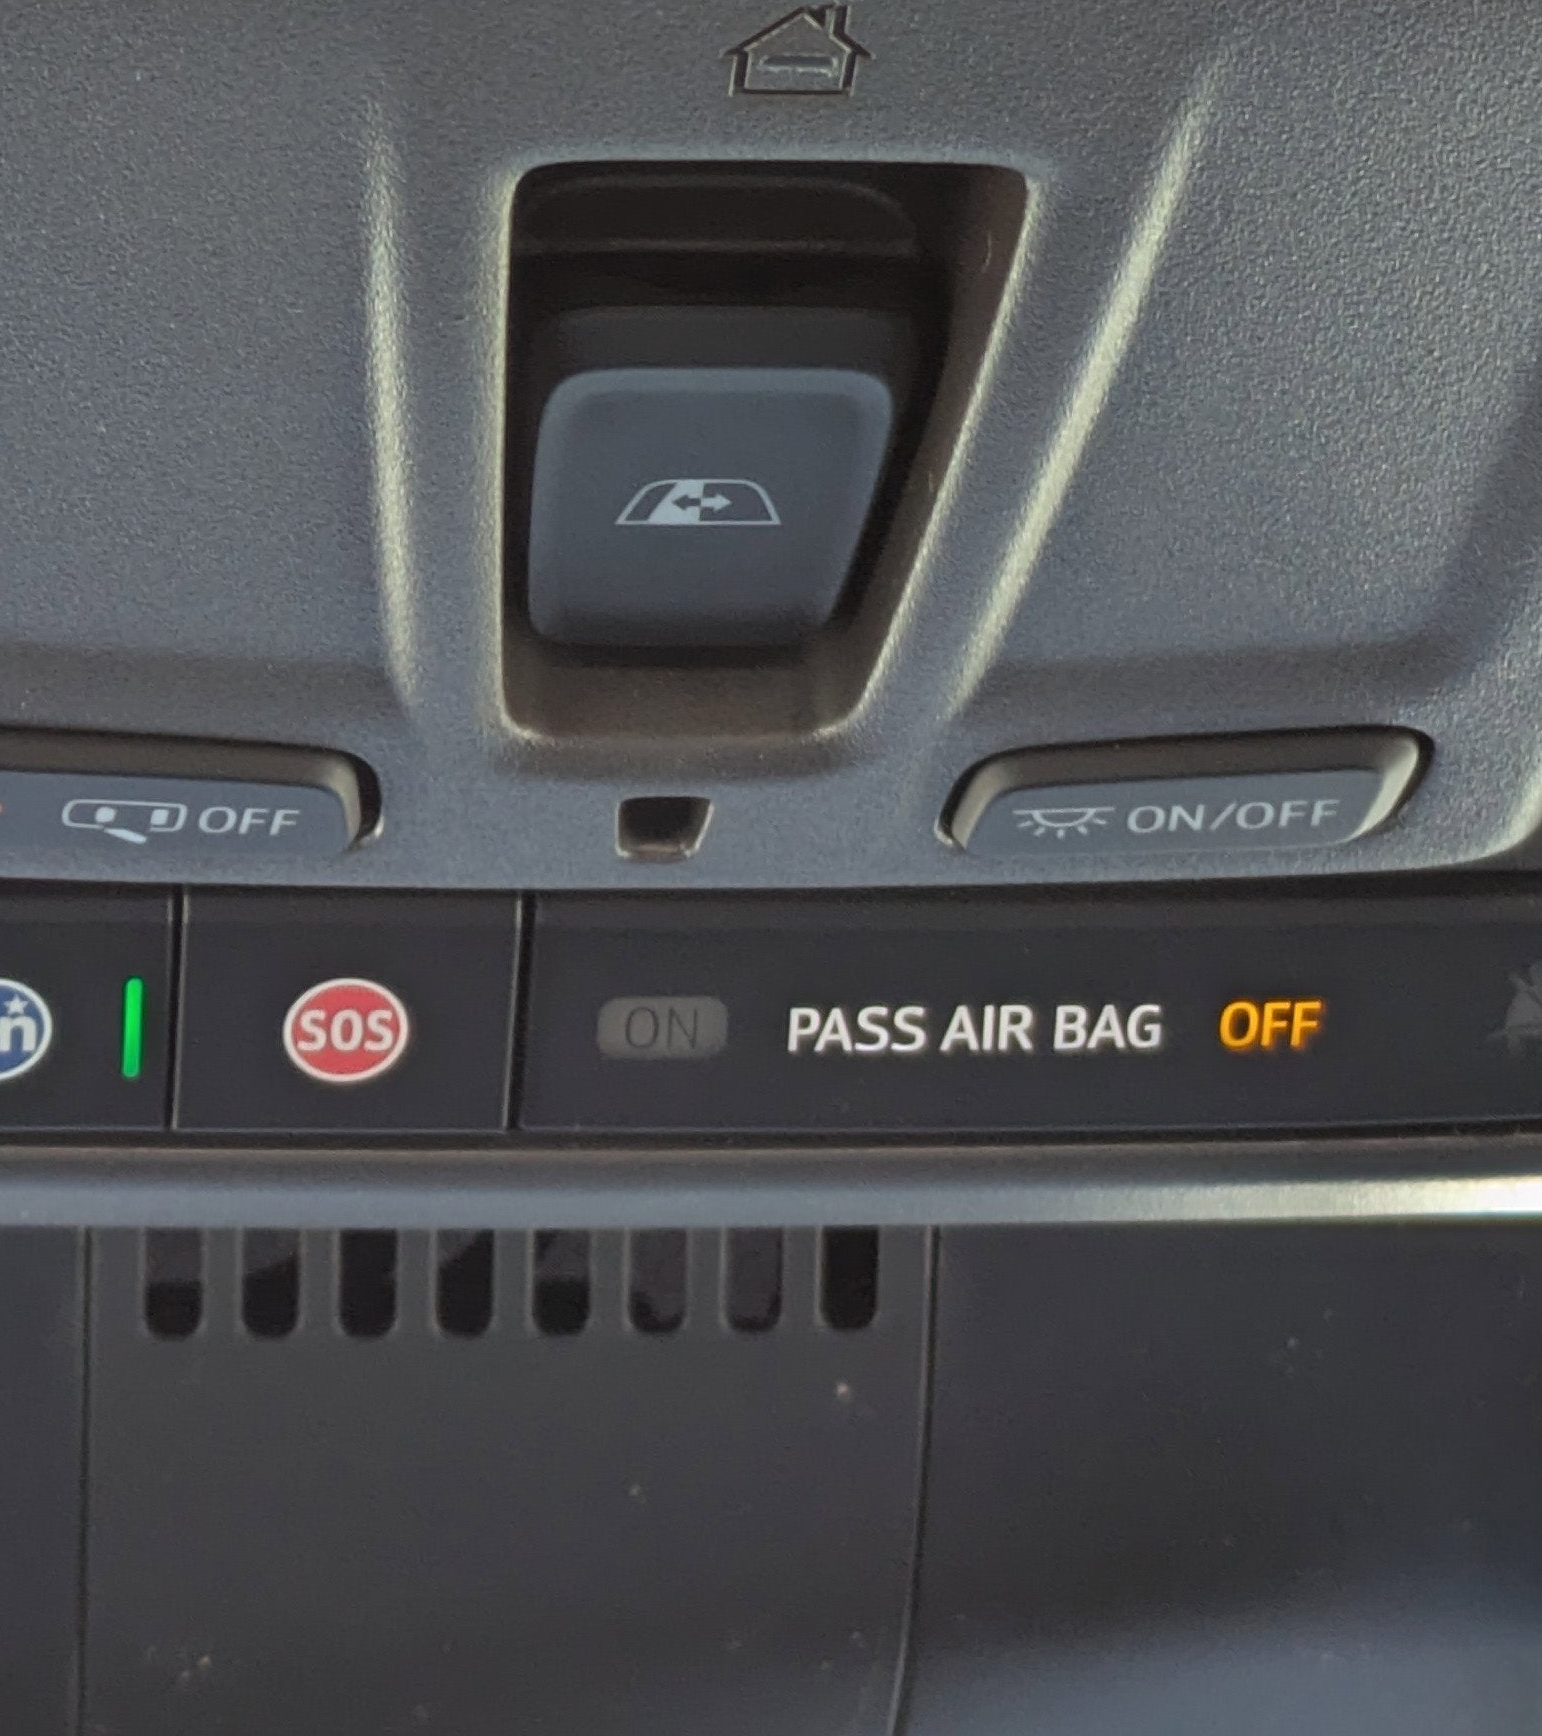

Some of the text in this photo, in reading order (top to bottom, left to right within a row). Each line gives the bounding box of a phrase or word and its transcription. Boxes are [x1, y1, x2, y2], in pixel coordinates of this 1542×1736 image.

[198, 805, 302, 836] OFF
[1126, 798, 1339, 834] ON/OFF
[296, 1008, 396, 1052] SOS
[624, 1001, 1321, 1053] ON PASS AIR BAG OFF
